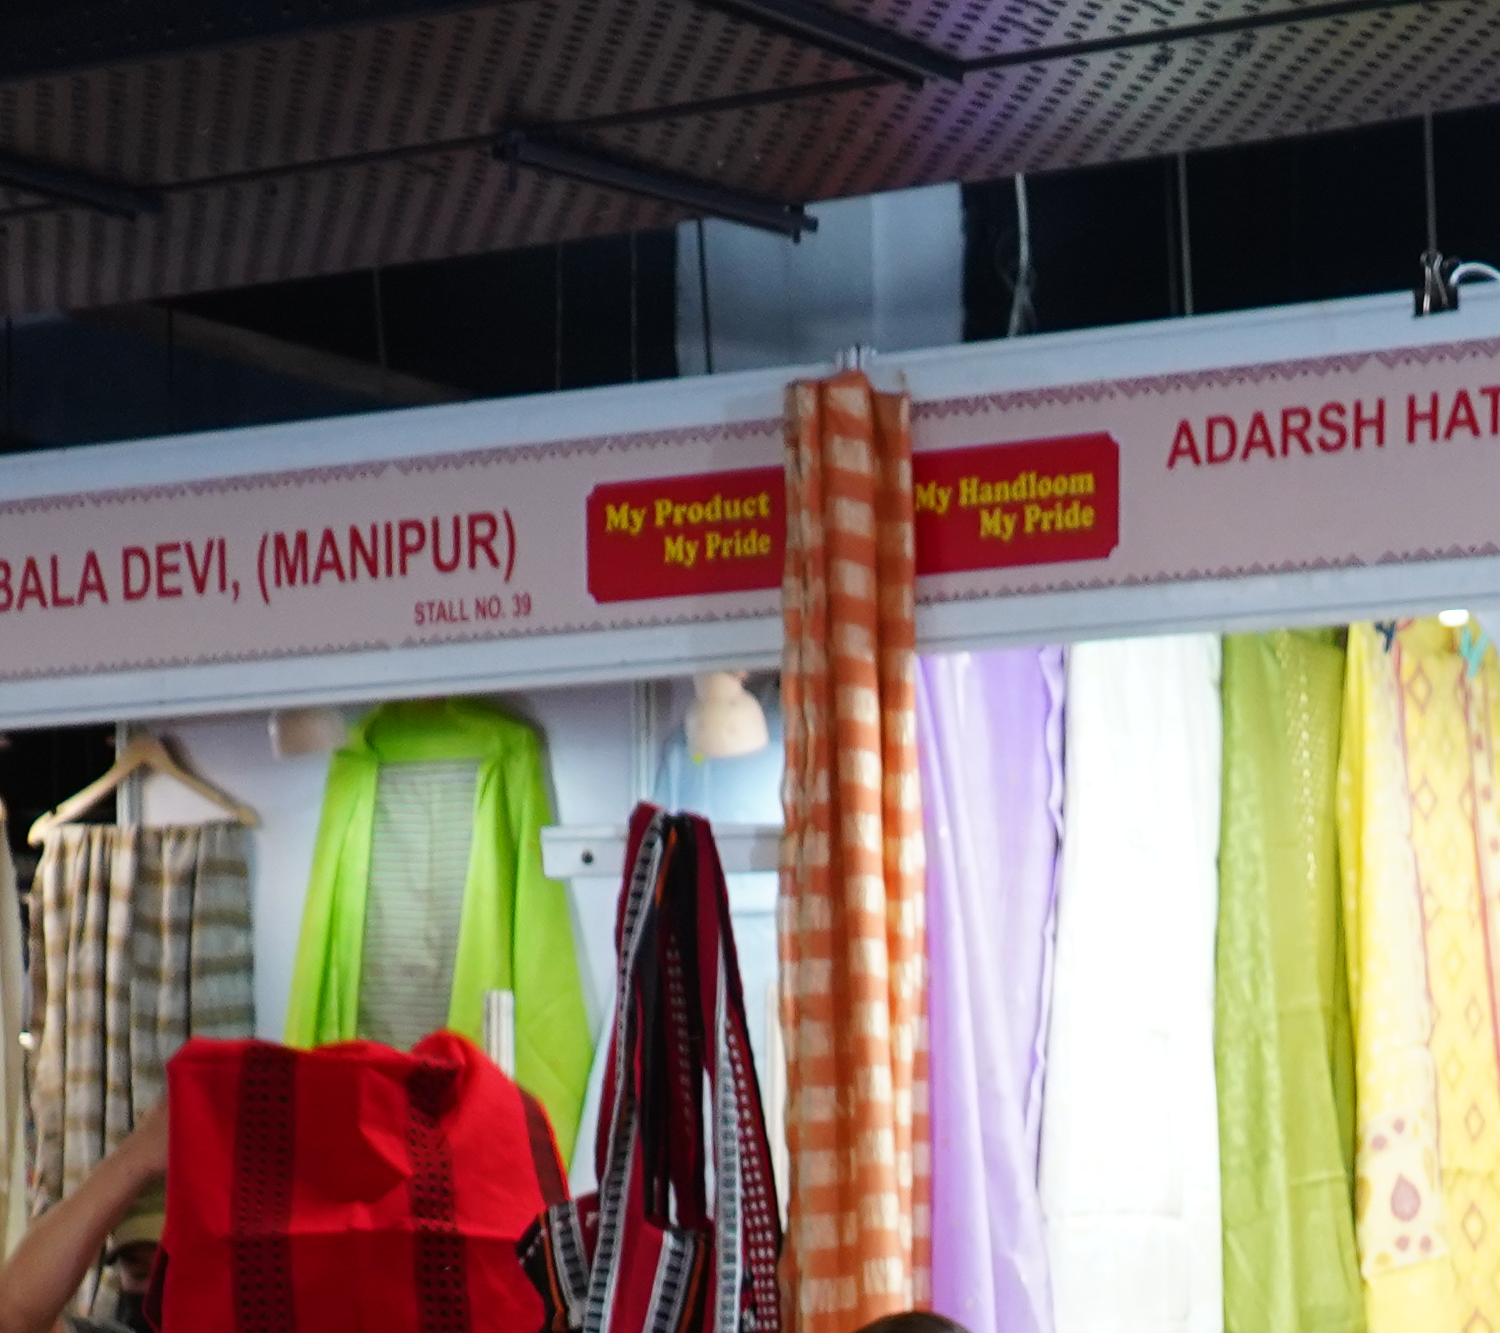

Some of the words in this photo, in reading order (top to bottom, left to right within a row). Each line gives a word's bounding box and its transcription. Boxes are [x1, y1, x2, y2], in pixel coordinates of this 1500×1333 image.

[1167, 397, 1387, 470] ADARSH
[605, 502, 648, 536] My
[654, 492, 771, 527] Product
[915, 480, 952, 515] My
[958, 469, 1095, 507] Handloom
[980, 507, 1018, 541] My
[1024, 500, 1095, 533] Pride
[123, 537, 240, 602] DEVI,
[257, 507, 516, 604] (MANIPUR)
[663, 534, 699, 568] My
[705, 527, 771, 561] Pride
[414, 599, 470, 626] STALL
[475, 595, 506, 620] NO.
[512, 592, 532, 617] 39
